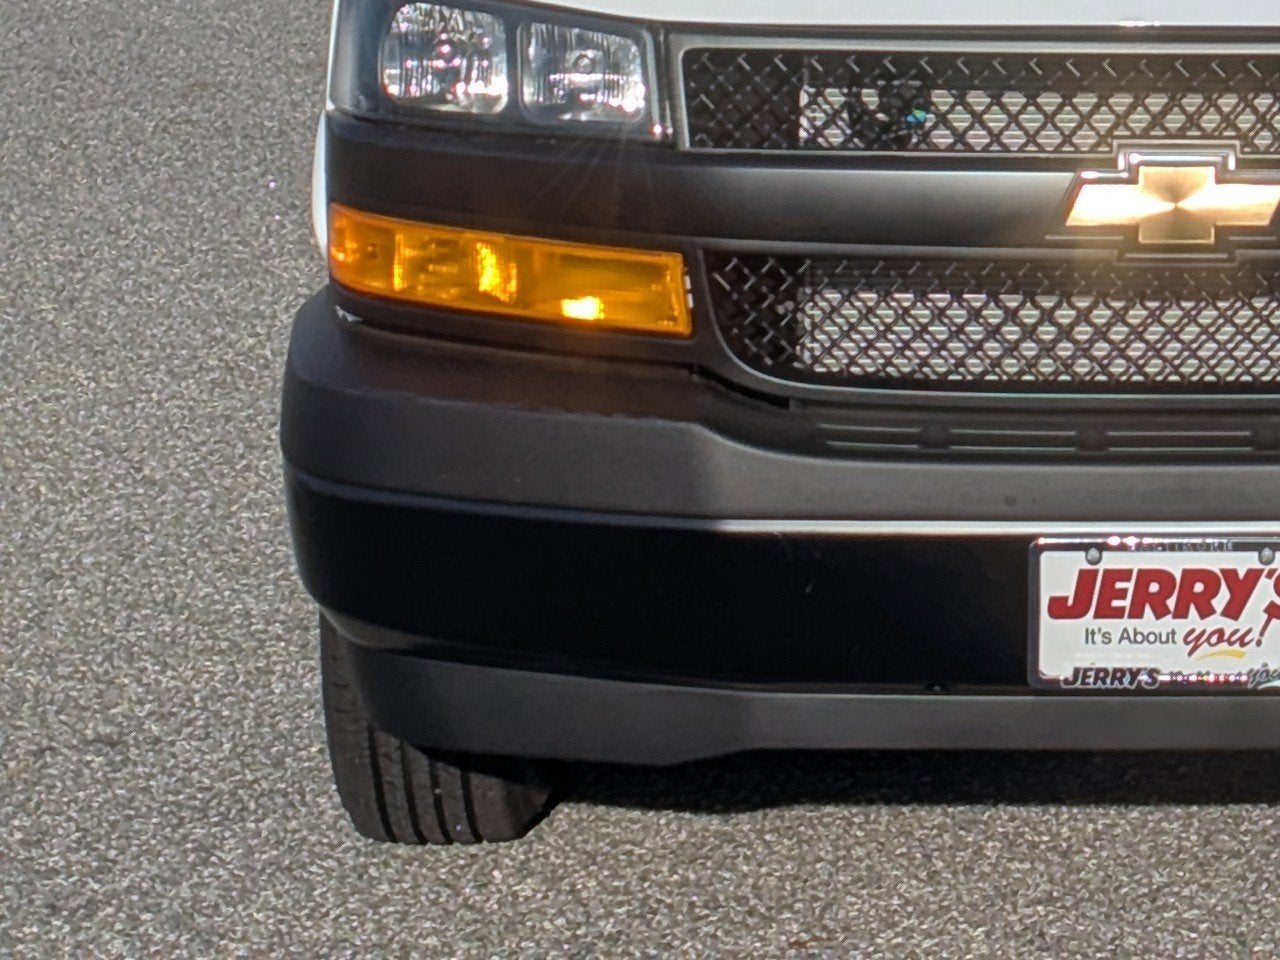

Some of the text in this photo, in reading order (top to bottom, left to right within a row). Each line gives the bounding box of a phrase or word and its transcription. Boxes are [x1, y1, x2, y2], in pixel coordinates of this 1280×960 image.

[1084, 617, 1274, 658] It's About you!
[1060, 665, 1162, 689] JERRY'S
